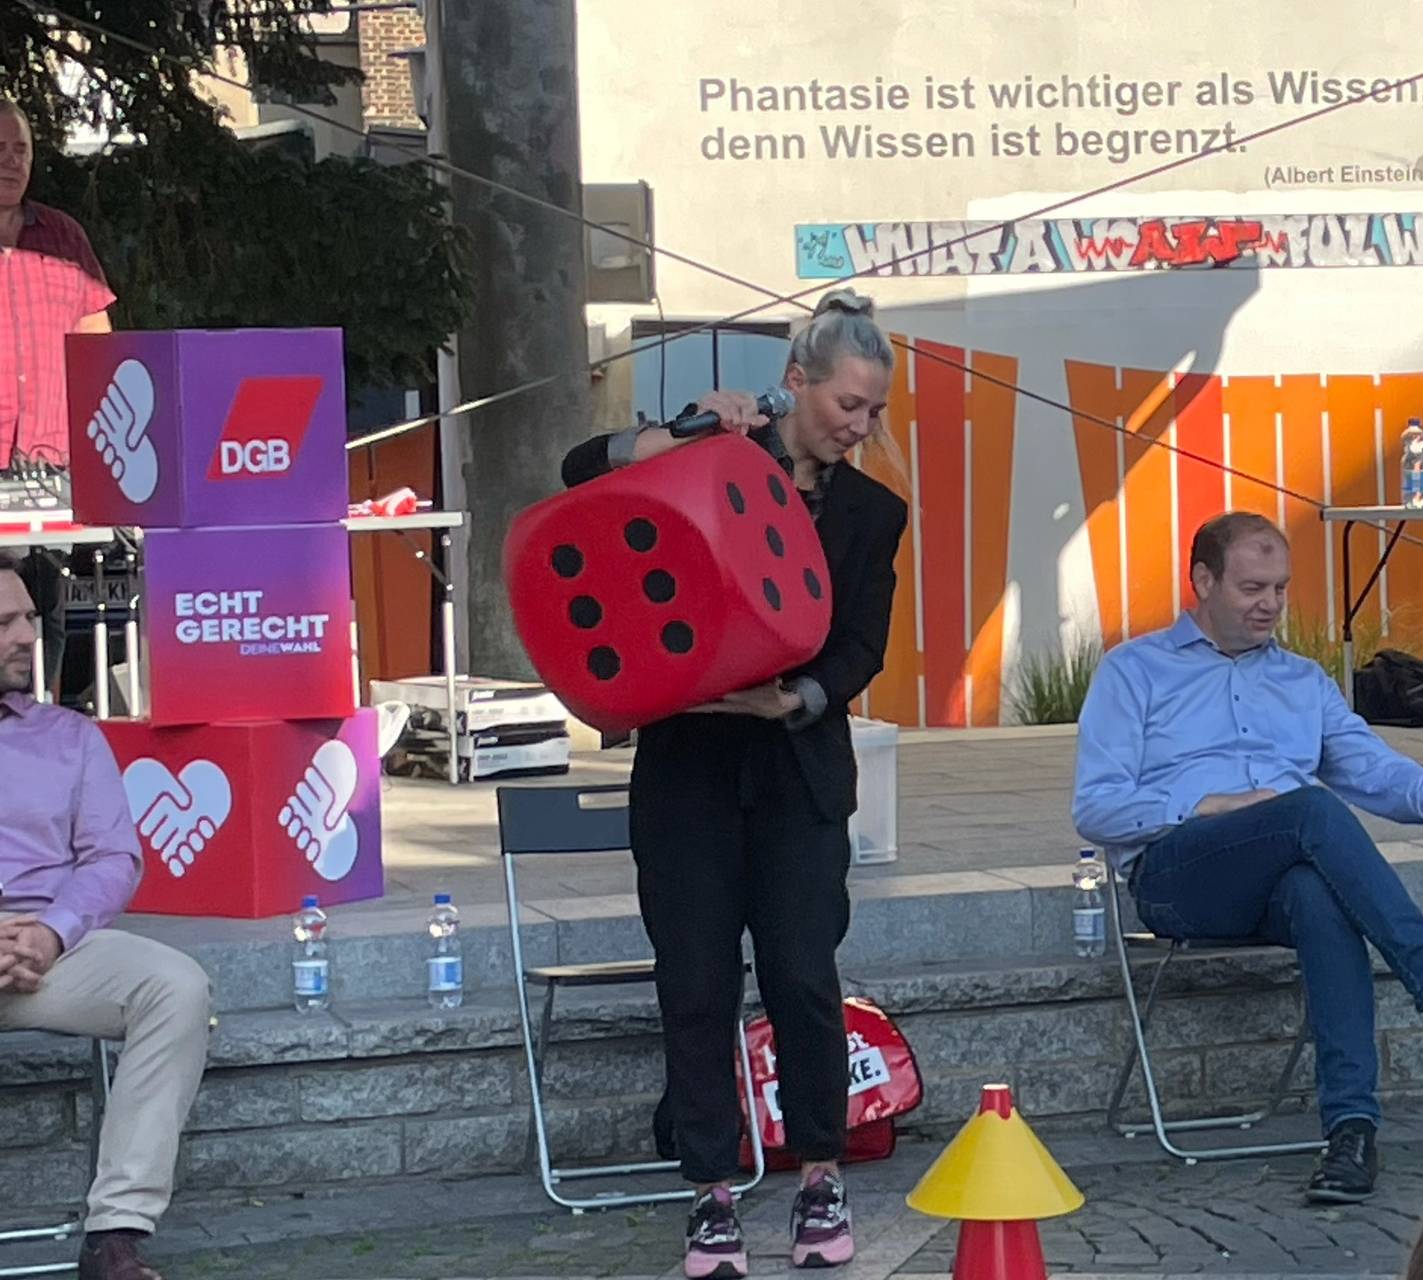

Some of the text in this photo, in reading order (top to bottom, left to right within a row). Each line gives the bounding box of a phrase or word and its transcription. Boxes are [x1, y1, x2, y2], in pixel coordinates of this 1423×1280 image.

[700, 76, 909, 112] Phantasie
[925, 75, 976, 110] ist
[988, 74, 1183, 116] wichtiger
[1195, 72, 1254, 106] als
[701, 121, 1248, 163] denn Wissen ist begrenzt.
[1264, 166, 1335, 188] (Albert
[220, 439, 291, 474] DGB
[175, 591, 263, 616] ECHT
[175, 614, 330, 644] GERECHT
